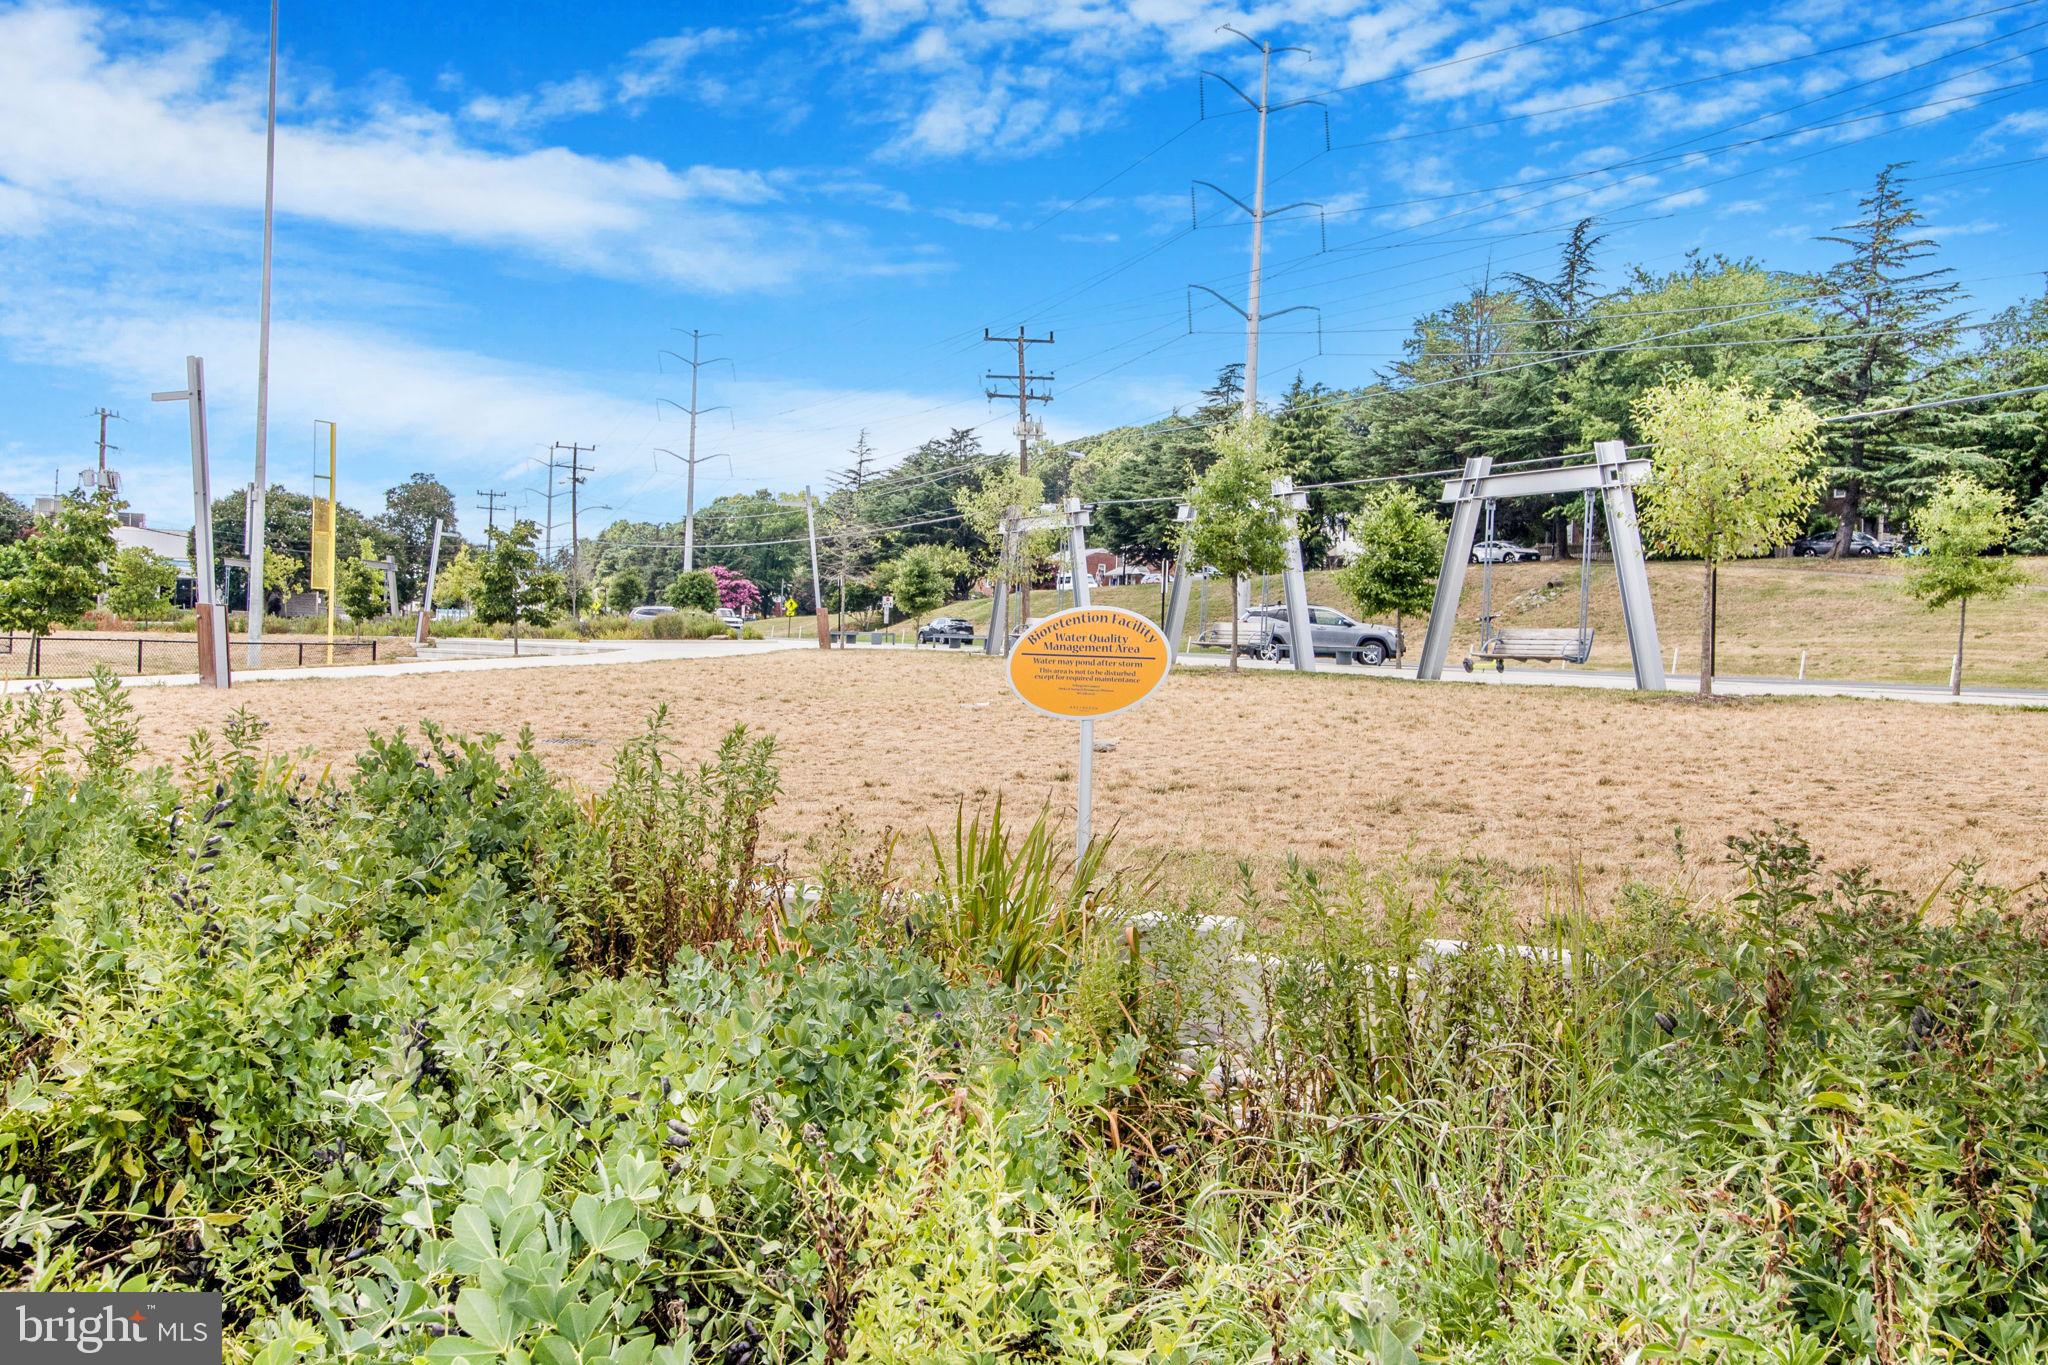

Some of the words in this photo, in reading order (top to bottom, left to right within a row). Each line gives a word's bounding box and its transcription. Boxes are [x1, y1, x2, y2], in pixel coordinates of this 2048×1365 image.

[1027, 612, 1108, 645] Bioretention
[1112, 613, 1158, 643] Facility
[1055, 632, 1087, 642] Water
[1089, 633, 1129, 643] Quality
[1043, 642, 1113, 653] Management
[1115, 644, 1140, 653] Area
[1033, 657, 1056, 665] Water
[1074, 659, 1096, 667] pond
